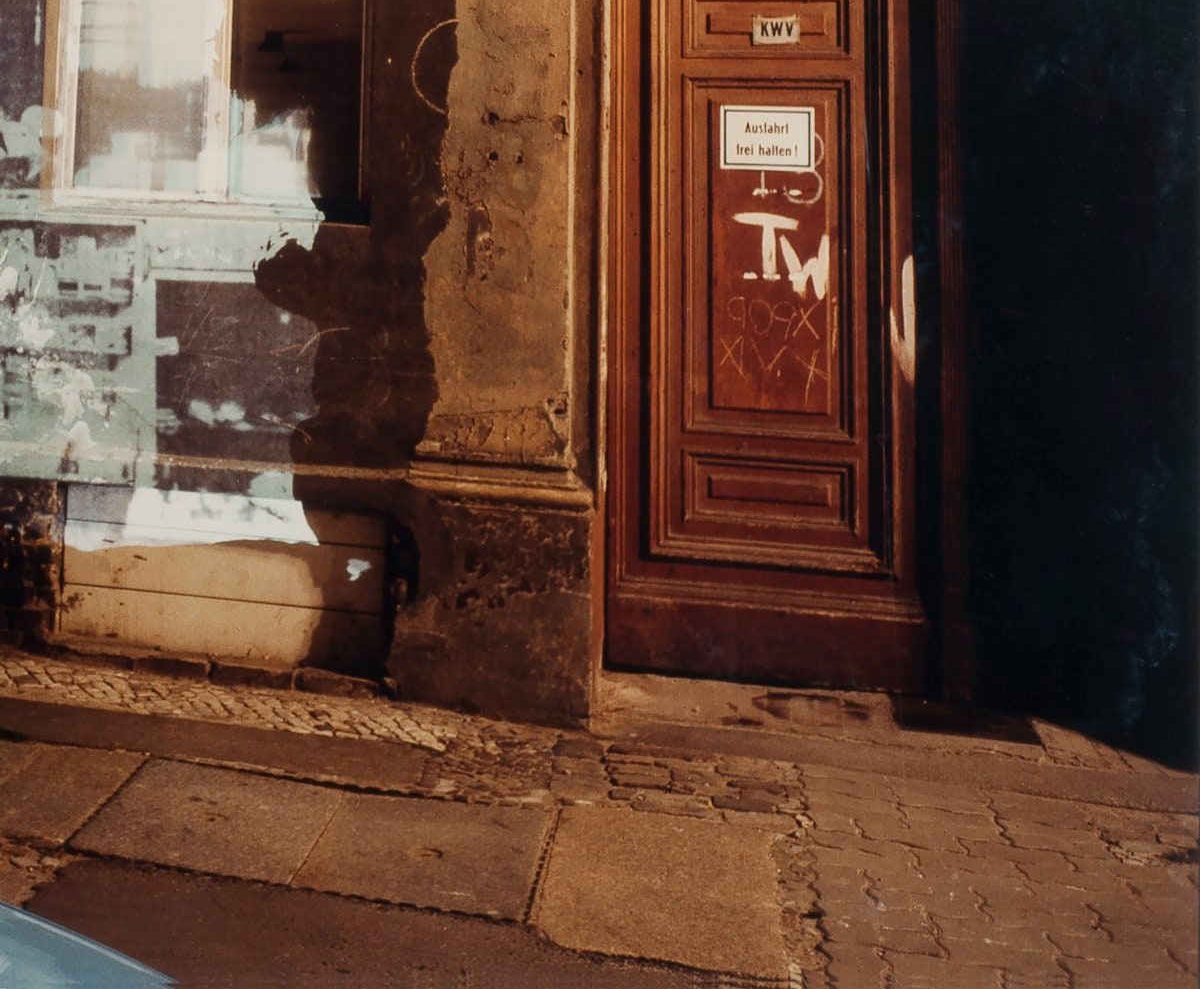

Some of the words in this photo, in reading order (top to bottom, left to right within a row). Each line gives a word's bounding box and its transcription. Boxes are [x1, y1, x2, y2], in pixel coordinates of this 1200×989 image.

[760, 21, 794, 37] KWV
[744, 122, 789, 135] Ausfahrt
[736, 143, 754, 156] frei
